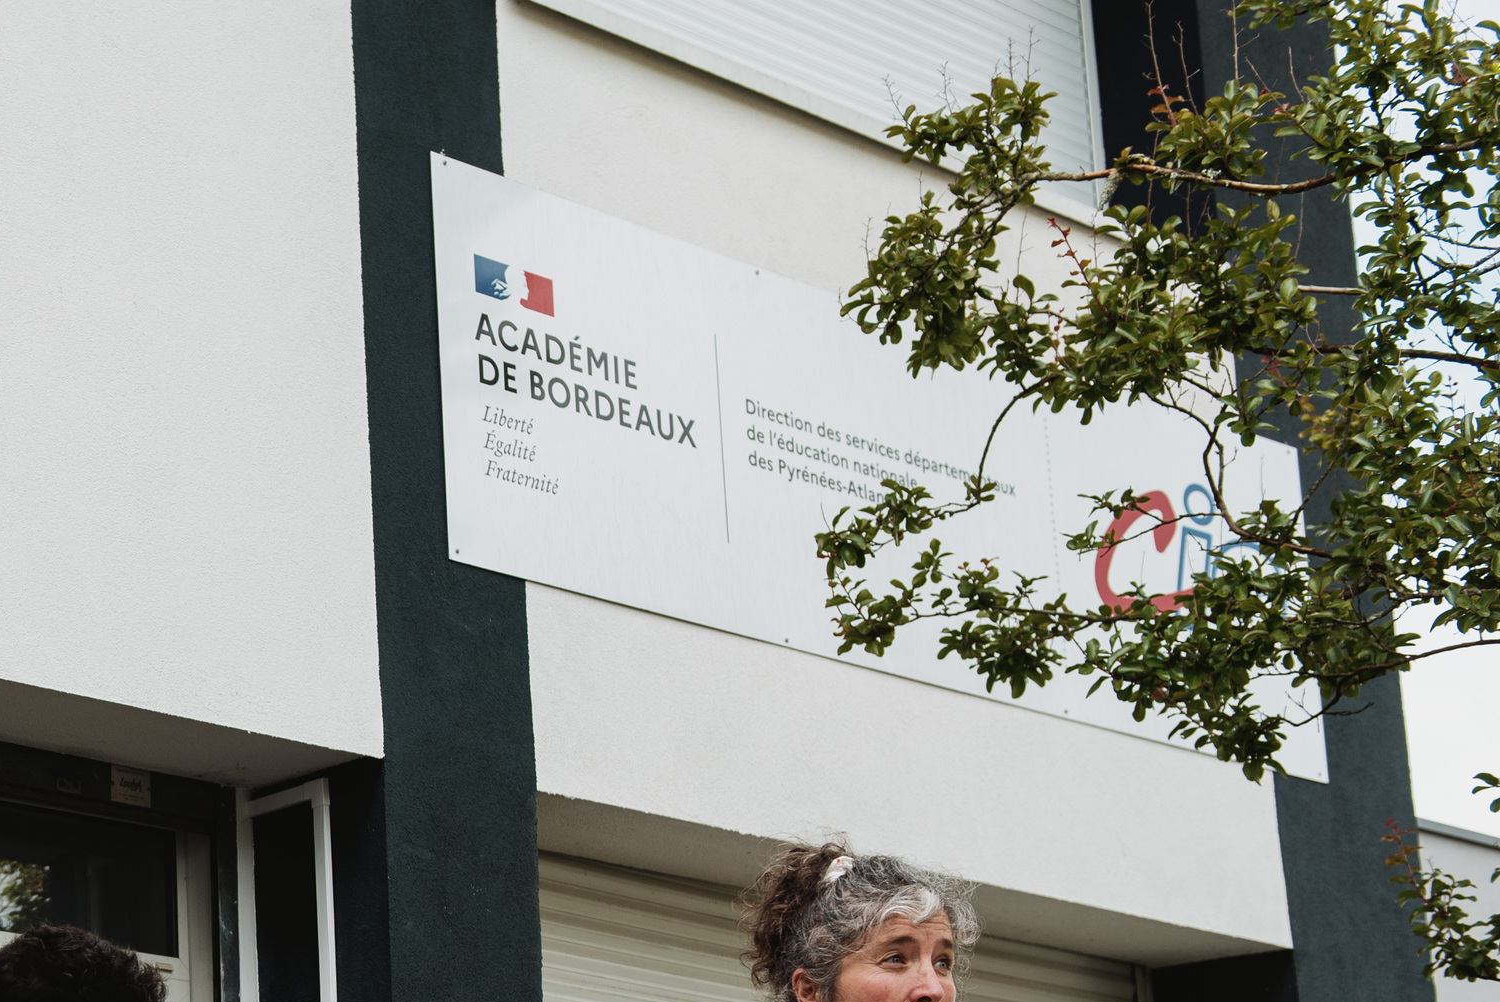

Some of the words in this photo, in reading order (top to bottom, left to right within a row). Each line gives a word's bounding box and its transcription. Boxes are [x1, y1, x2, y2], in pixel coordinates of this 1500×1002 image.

[475, 312, 638, 390] ACADÉMIE
[478, 353, 518, 394] DE
[529, 369, 698, 449] BORDEAUX
[482, 405, 534, 435] Liberté
[483, 429, 536, 462] Égalité
[745, 398, 813, 433] Direction
[817, 421, 841, 442] des
[845, 433, 901, 461] services
[484, 459, 559, 495] Fraternité
[746, 424, 765, 444] de
[769, 429, 849, 469] l'éducation
[853, 460, 918, 488] nationale
[748, 450, 774, 472] des
